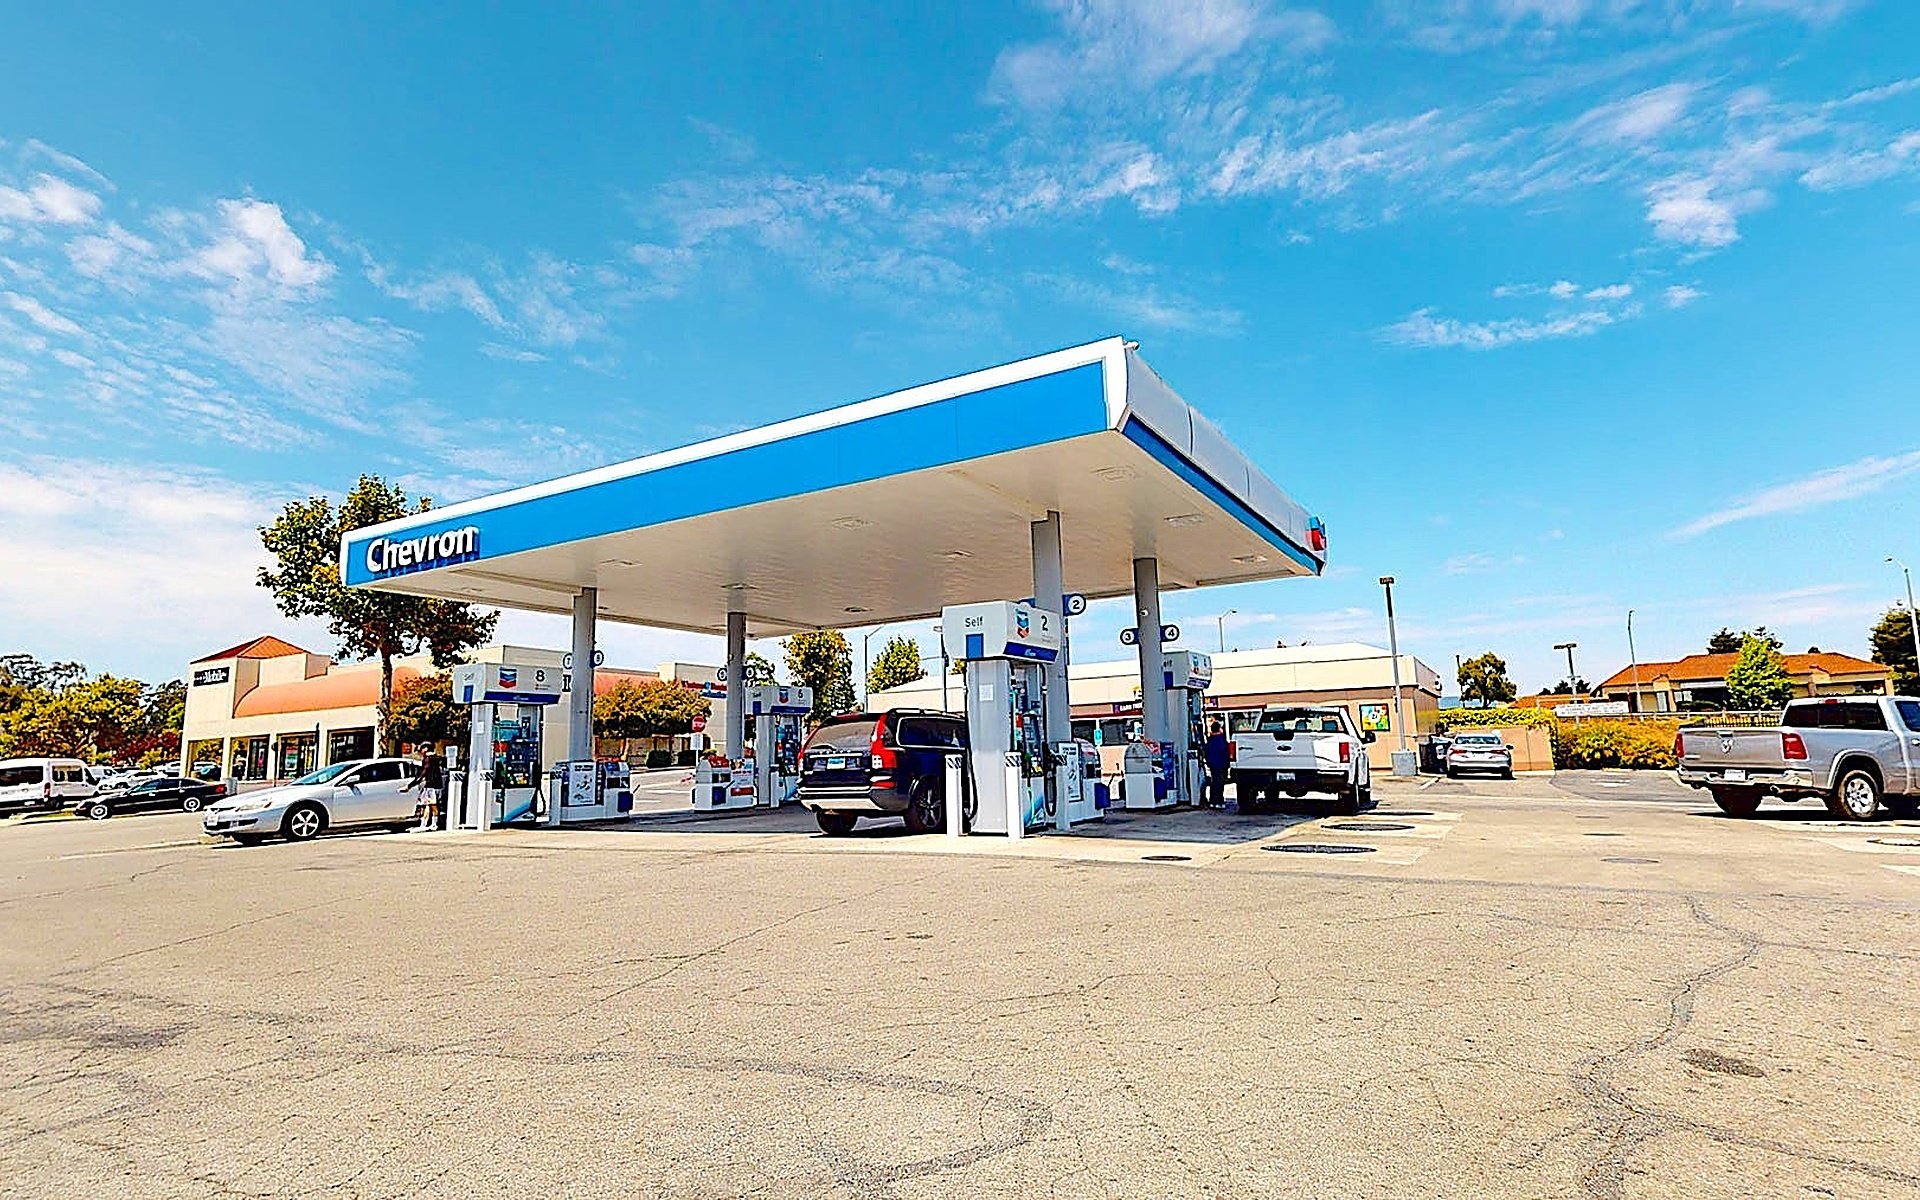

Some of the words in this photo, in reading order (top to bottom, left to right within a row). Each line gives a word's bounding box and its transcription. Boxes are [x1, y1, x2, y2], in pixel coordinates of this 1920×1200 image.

[366, 526, 480, 573] Chevron
[965, 616, 984, 628] Self
[1040, 615, 1049, 632] 2
[535, 669, 545, 682] 8
